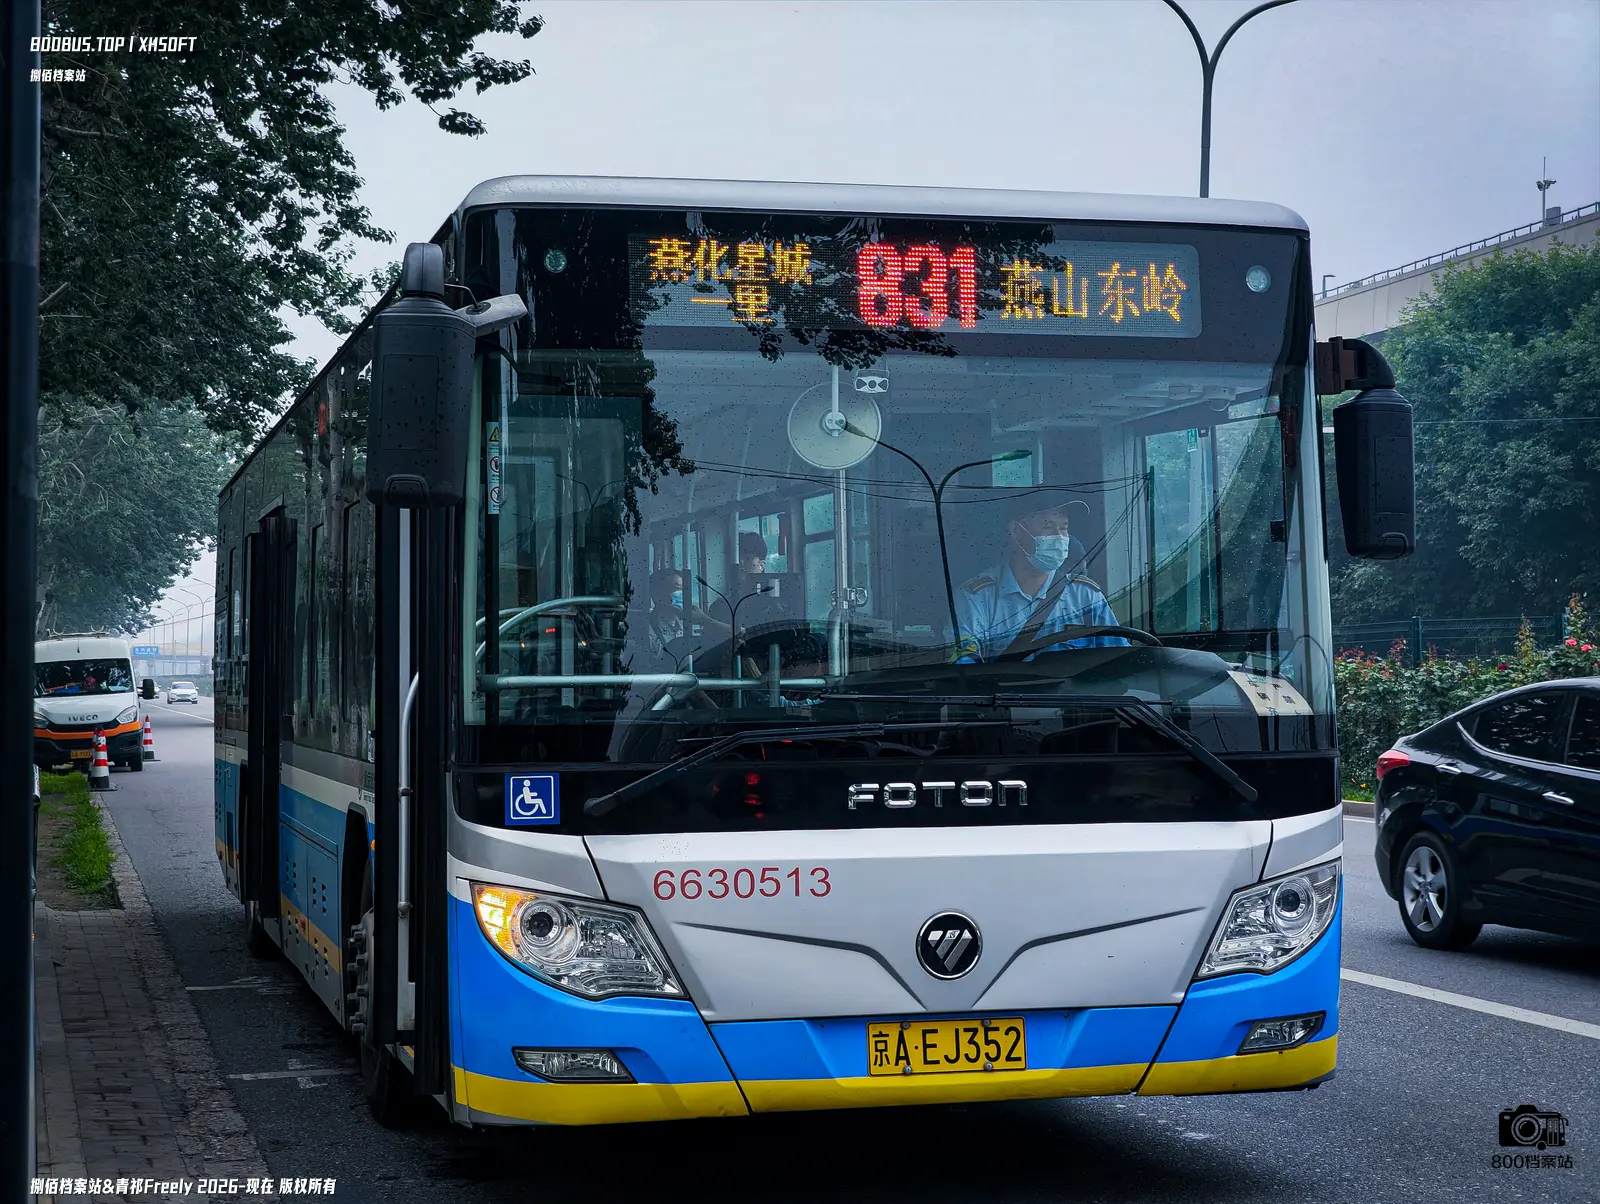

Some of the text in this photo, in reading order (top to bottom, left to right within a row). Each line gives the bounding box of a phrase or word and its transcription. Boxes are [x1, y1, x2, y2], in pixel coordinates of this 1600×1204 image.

[648, 238, 812, 286] 燕化星城
[690, 284, 773, 323] 一里
[857, 243, 977, 329] 831
[999, 259, 1187, 324] 燕山东岭
[68, 714, 99, 722] IVECO
[848, 780, 1028, 810] FOTON
[653, 866, 832, 901] 6630513
